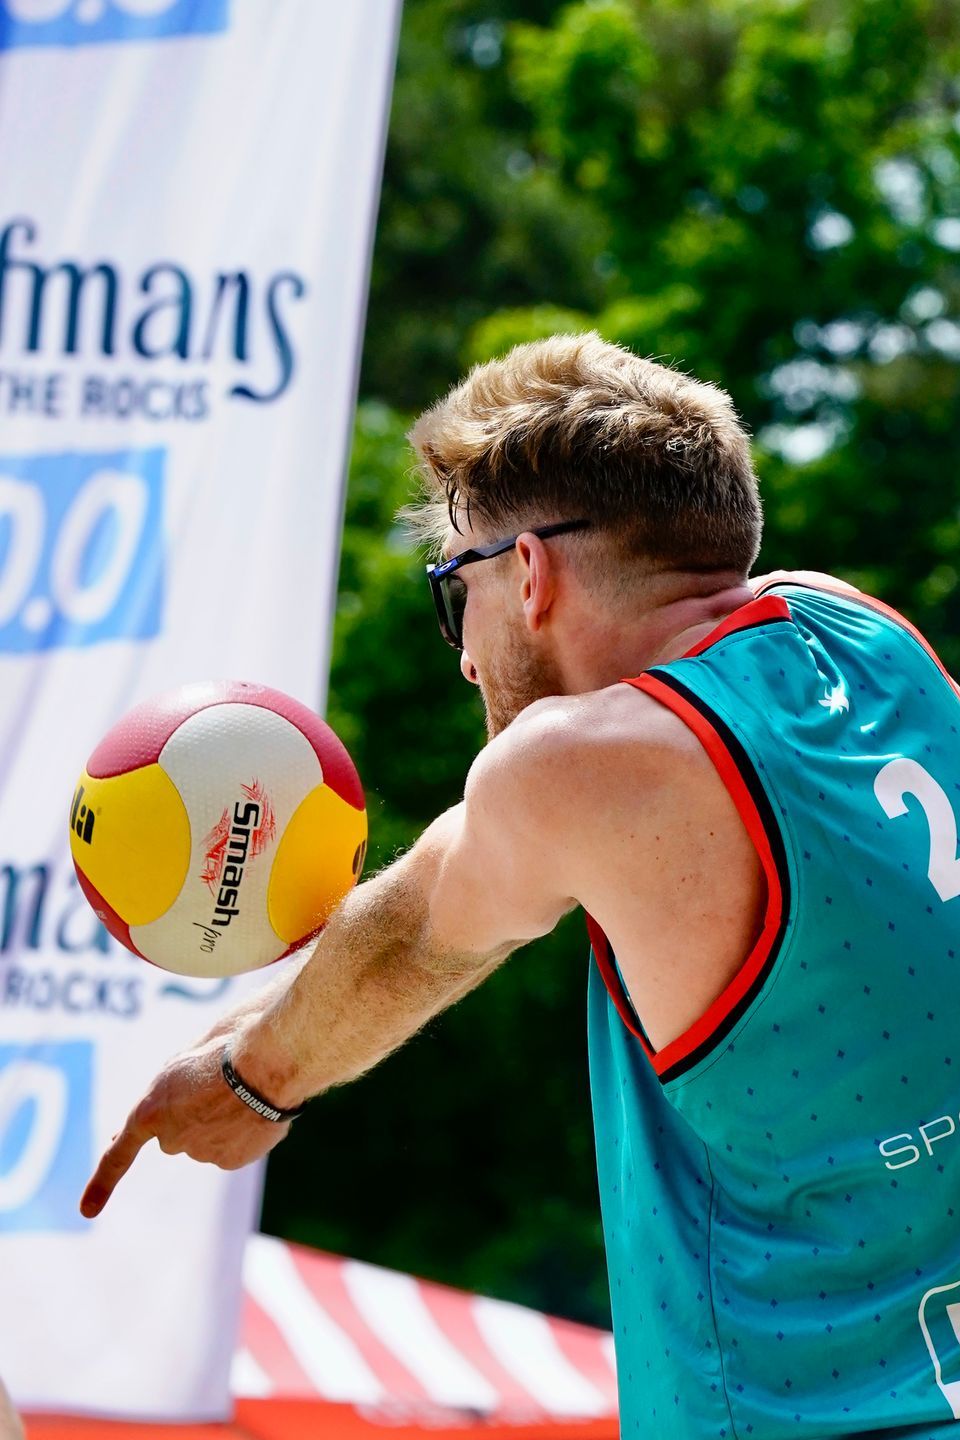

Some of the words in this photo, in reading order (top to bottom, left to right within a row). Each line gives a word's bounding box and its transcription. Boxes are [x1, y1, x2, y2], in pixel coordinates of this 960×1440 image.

[0, 372, 60, 418] HE
[80, 374, 211, 422] ROCKS
[211, 801, 260, 927] Smash
[192, 921, 223, 954] pro
[234, 1084, 282, 1122] WARRIOR
